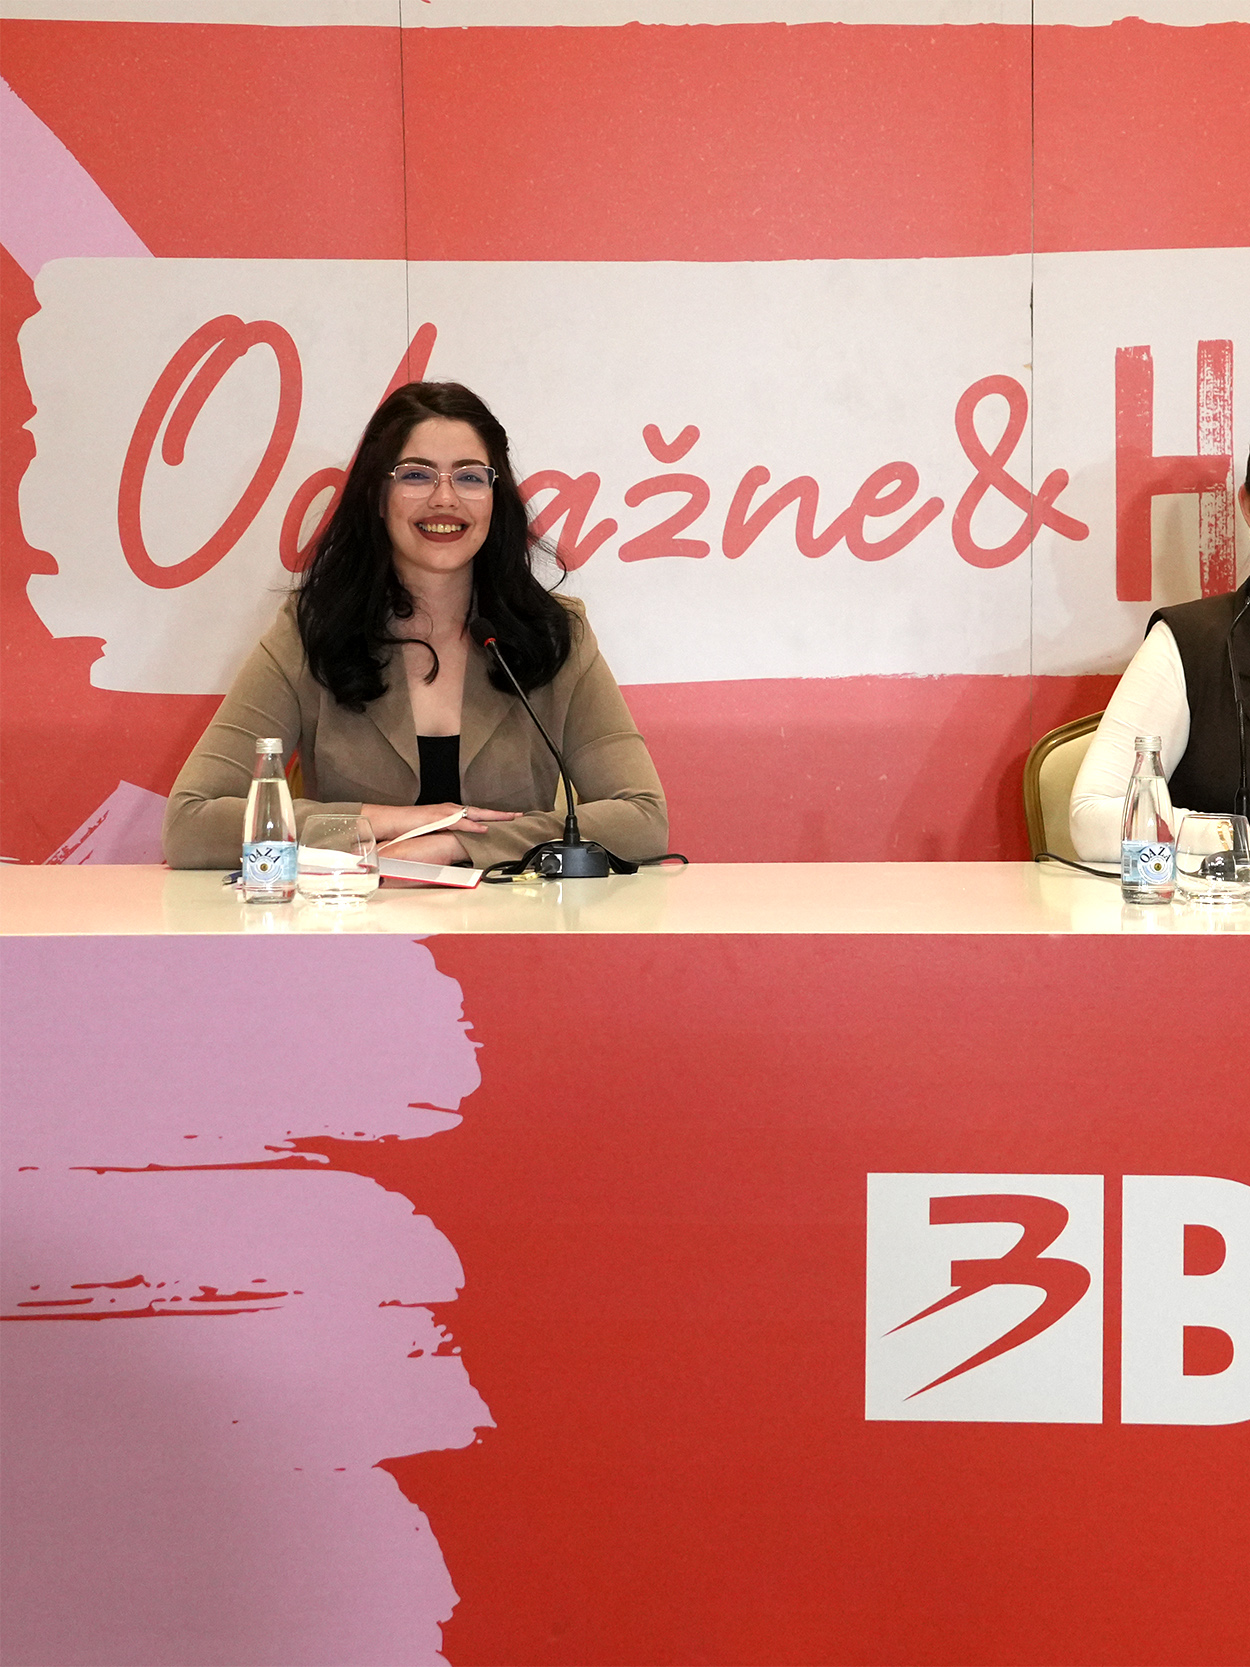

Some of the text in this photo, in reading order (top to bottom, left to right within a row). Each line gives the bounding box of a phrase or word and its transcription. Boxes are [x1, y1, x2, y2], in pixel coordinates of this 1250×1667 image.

[117, 314, 945, 590] Odažne
[951, 374, 1089, 569] &
[248, 847, 281, 864] OAZA
[1139, 846, 1172, 863] OAZA
